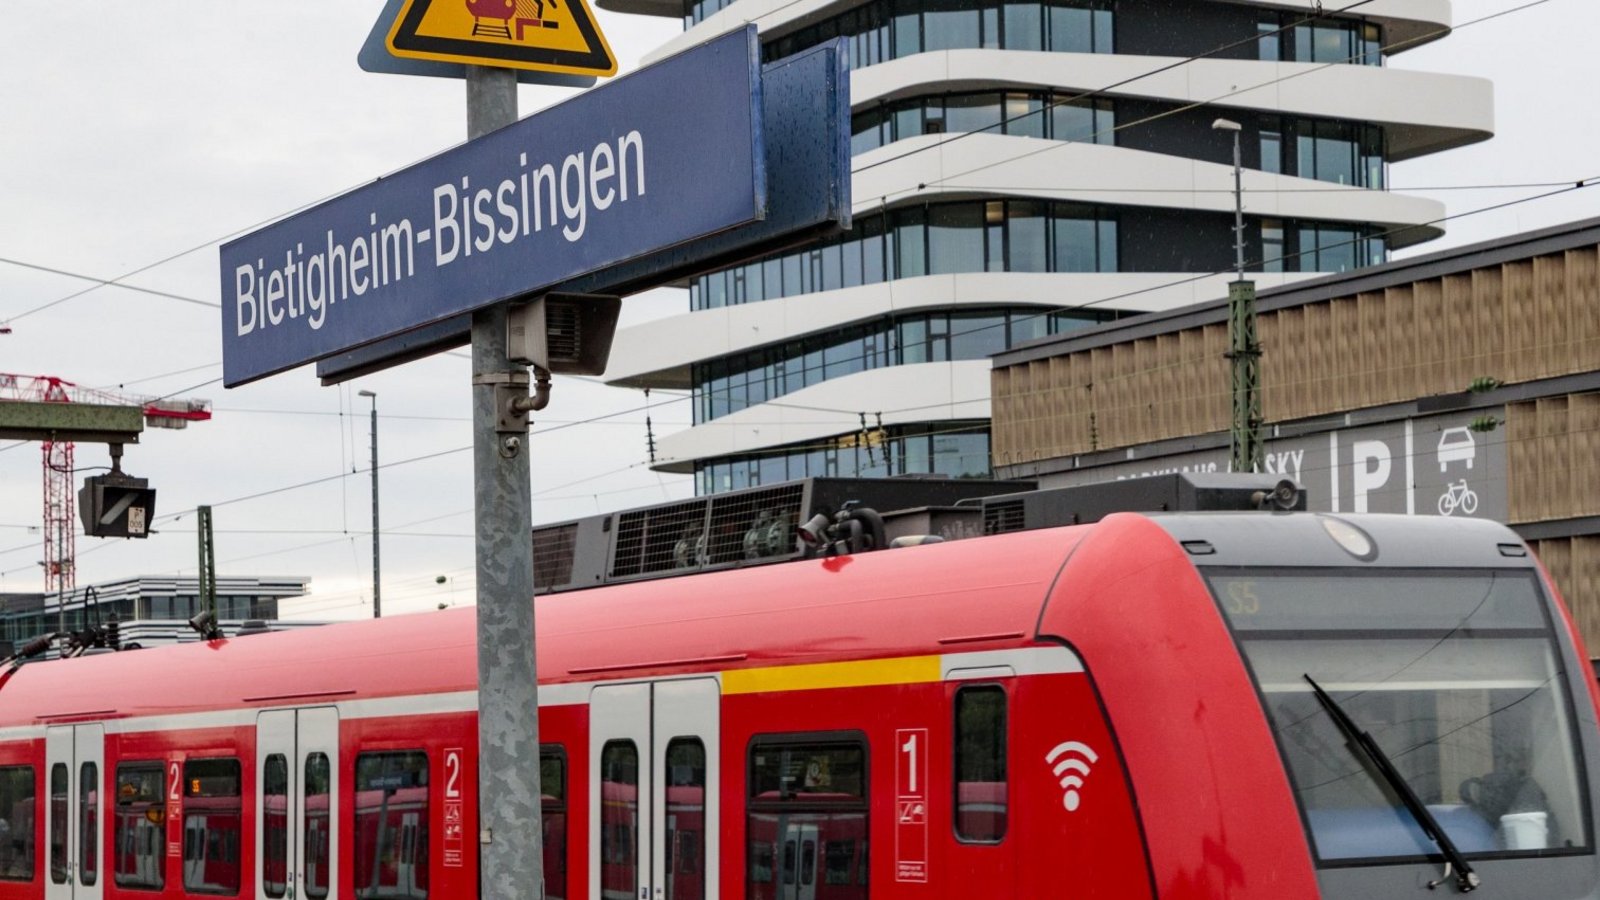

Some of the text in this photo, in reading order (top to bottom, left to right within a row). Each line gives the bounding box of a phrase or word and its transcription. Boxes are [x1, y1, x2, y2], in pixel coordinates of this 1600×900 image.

[236, 130, 646, 337] Bietigheim-Bissingen
[1353, 440, 1391, 513] P
[1228, 581, 1259, 614] S5
[170, 763, 179, 800] 2
[446, 752, 459, 797] 2
[902, 734, 917, 792] 1
